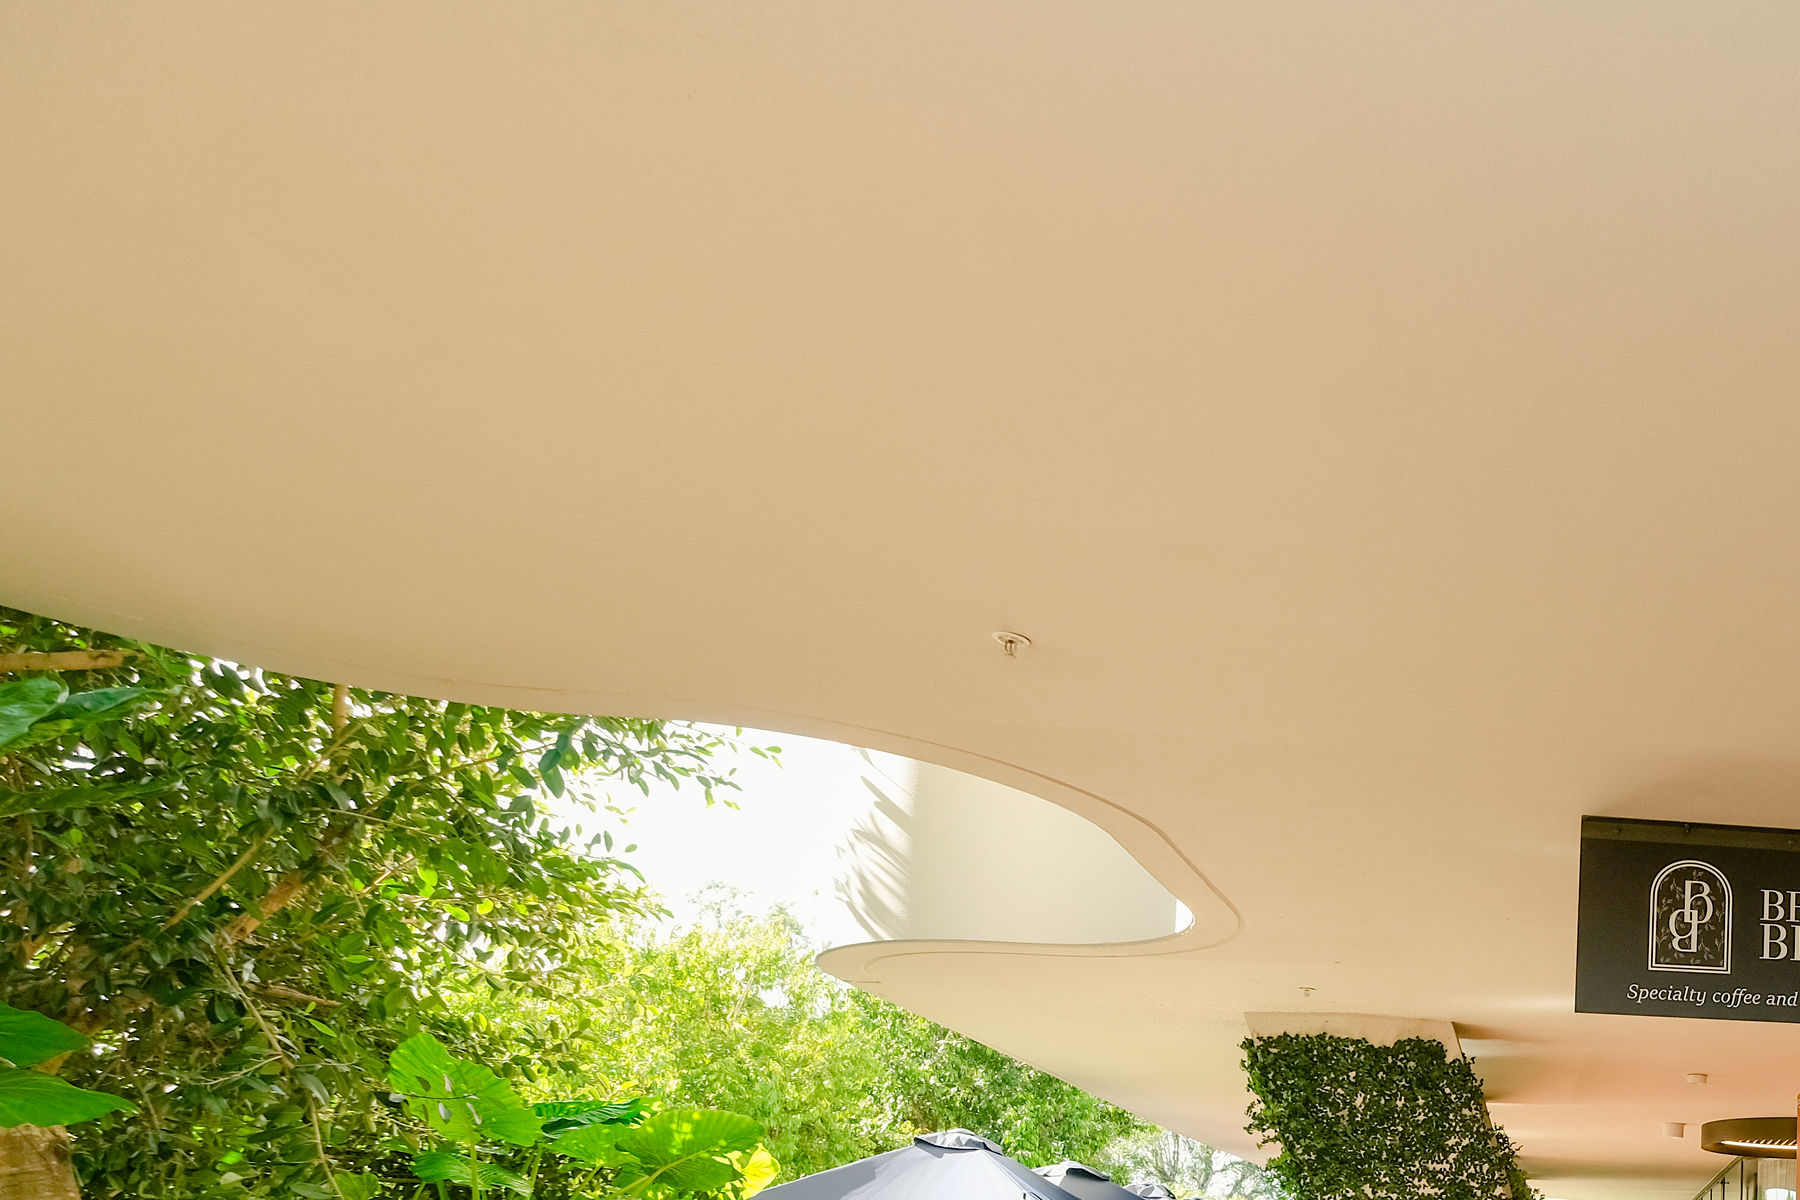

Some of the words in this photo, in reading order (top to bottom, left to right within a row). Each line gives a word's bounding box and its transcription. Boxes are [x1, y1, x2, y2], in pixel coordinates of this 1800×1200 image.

[1626, 983, 1707, 1008] Specialty
[1711, 989, 1761, 1009] coffee
[1765, 991, 1799, 1007] and
